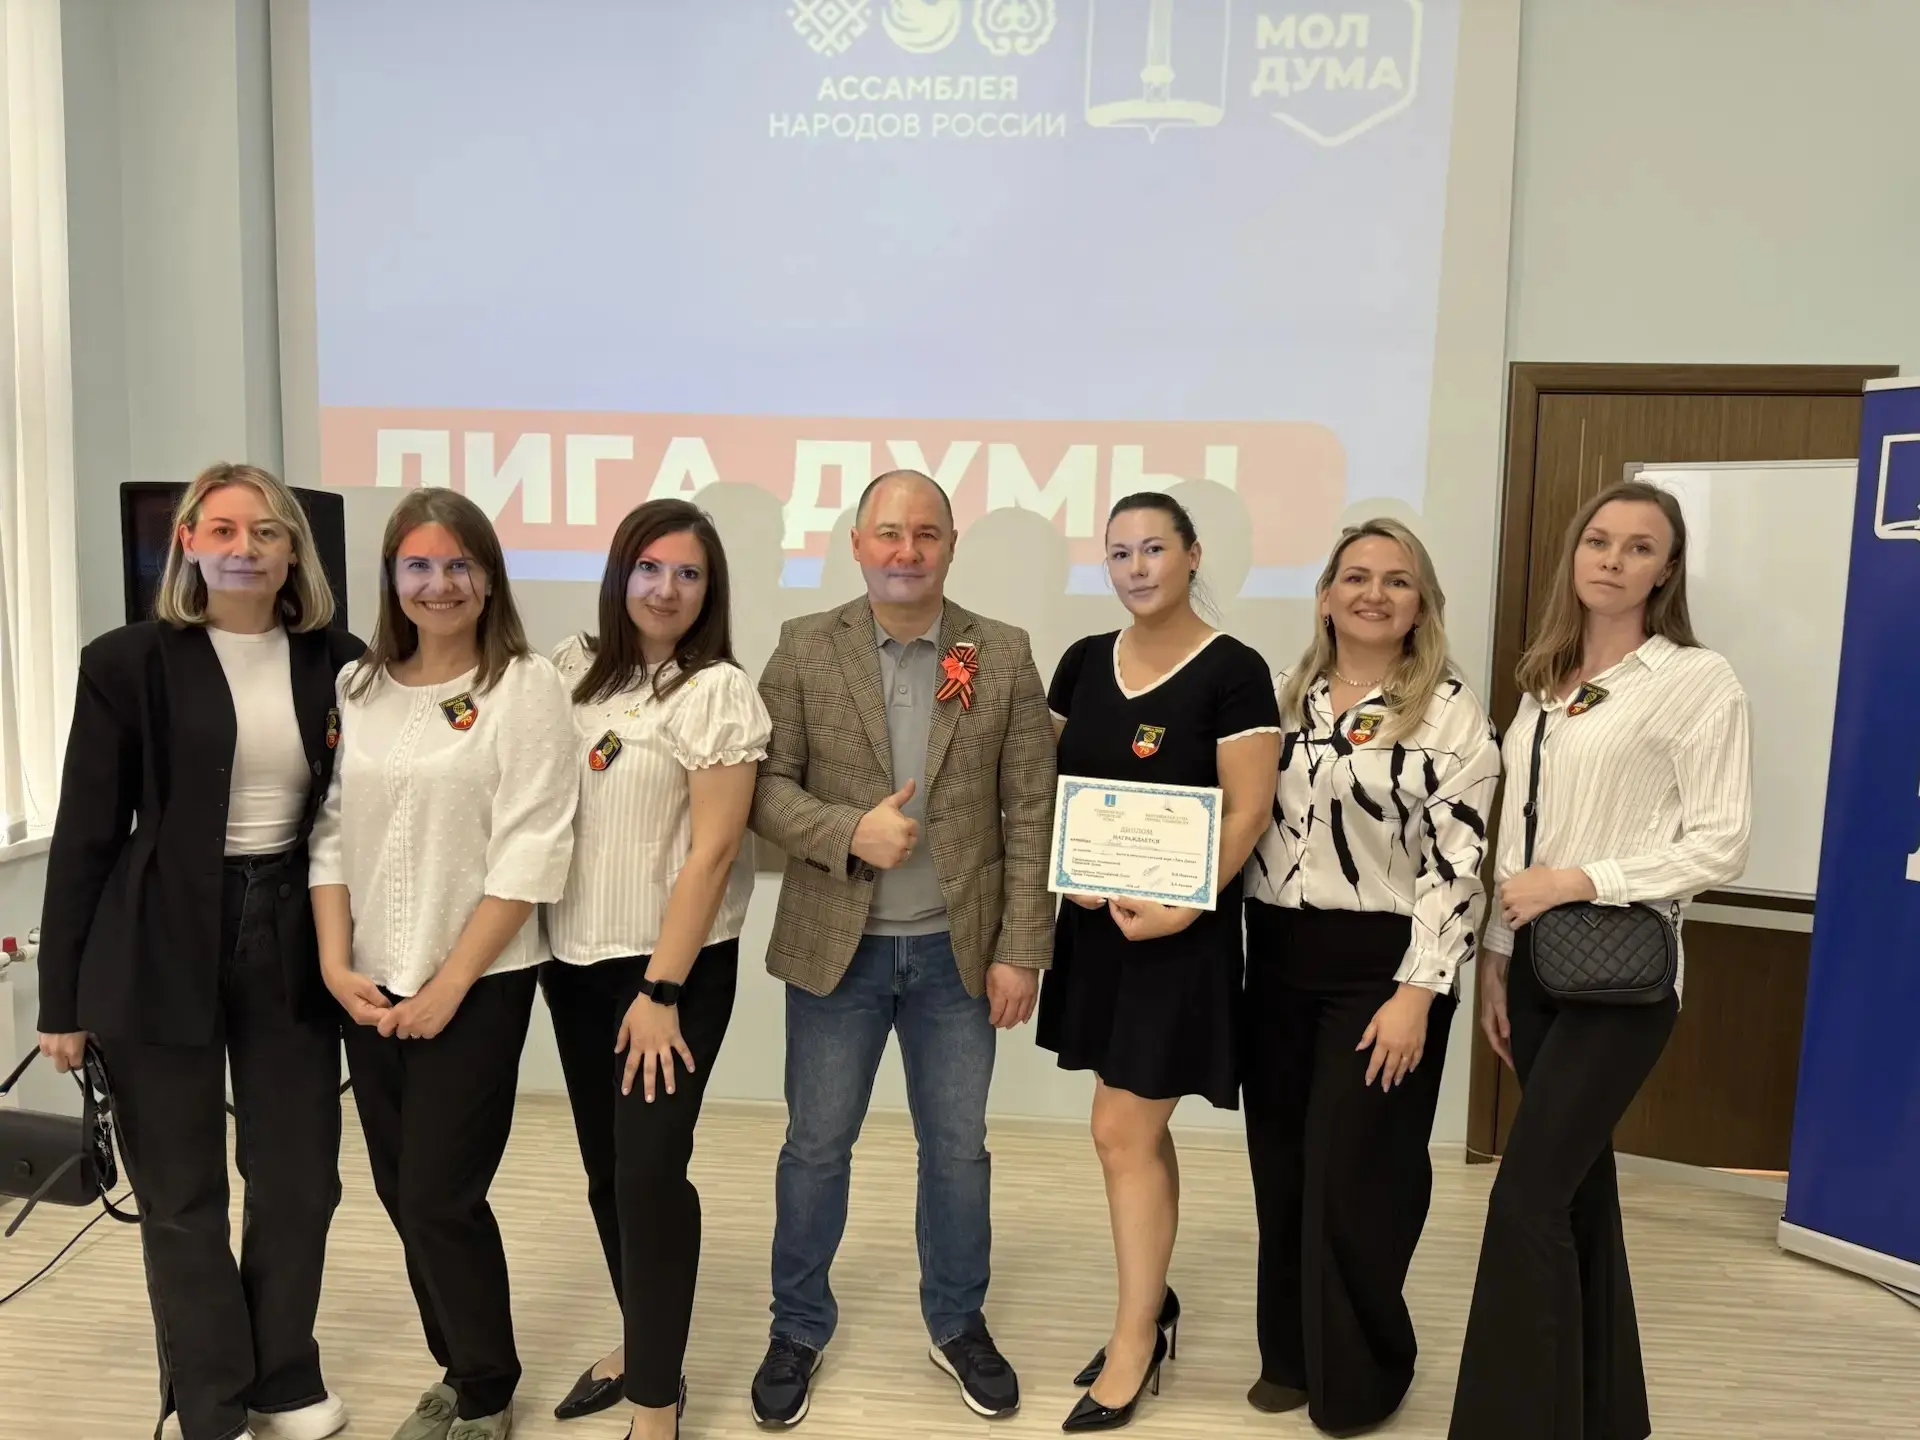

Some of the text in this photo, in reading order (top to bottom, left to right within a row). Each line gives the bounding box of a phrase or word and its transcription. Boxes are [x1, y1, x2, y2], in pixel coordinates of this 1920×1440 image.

[1256, 13, 1370, 50] МОЛ
[817, 75, 1019, 102] АССАМБЛЕЯ
[1251, 55, 1403, 98] ДУМА
[768, 112, 1067, 143] НАРОДОВ РОССИИ
[1113, 834, 1160, 844] НАГРАЖДАЕТСЯ
[1120, 826, 1153, 836] ДИПЛОМ
